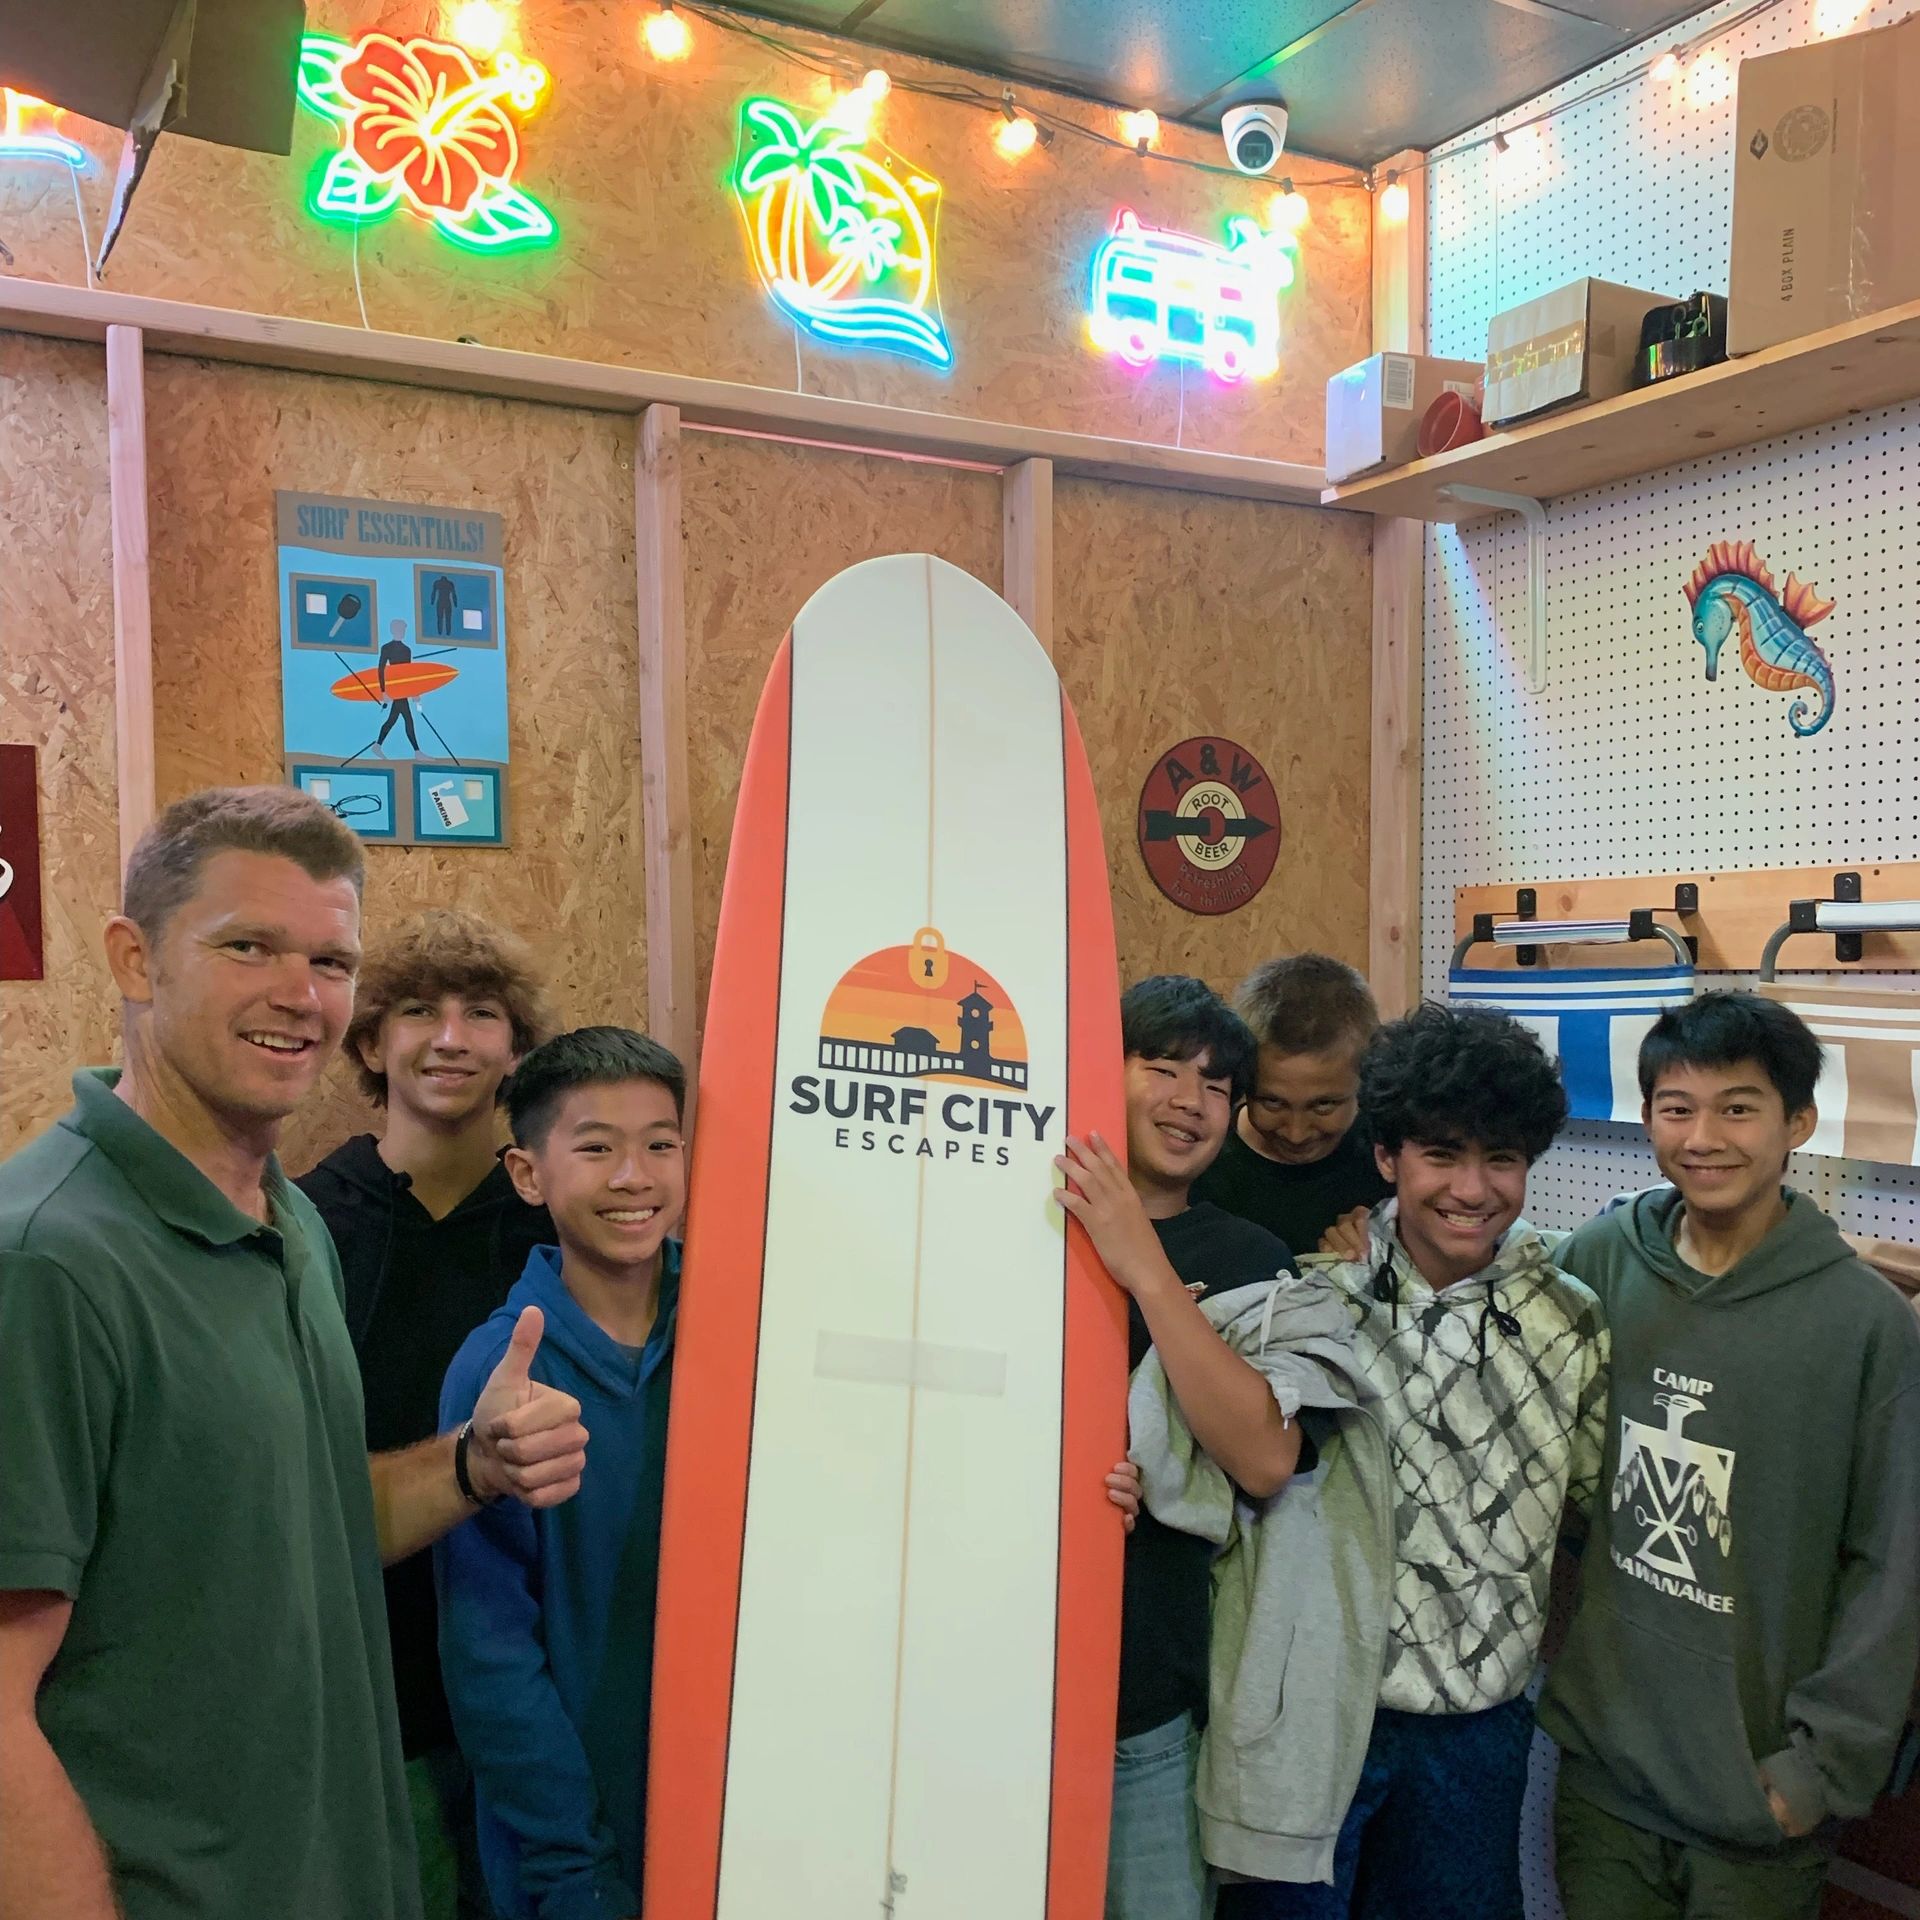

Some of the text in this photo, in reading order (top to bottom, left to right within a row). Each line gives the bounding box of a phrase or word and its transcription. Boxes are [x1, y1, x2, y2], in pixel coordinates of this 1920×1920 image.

[1780, 228, 1795, 302] 4 BOX PLAIN
[297, 504, 485, 553] SURF ESSENTIALS!
[1165, 743, 1263, 794] A & W
[431, 791, 452, 827] PARKING
[1192, 793, 1230, 811] ROOT
[1194, 842, 1230, 858] BEER
[789, 1075, 1056, 1142] SURF CITY
[835, 1128, 1010, 1166] ESCAPES
[1653, 1367, 1714, 1396] CAMP
